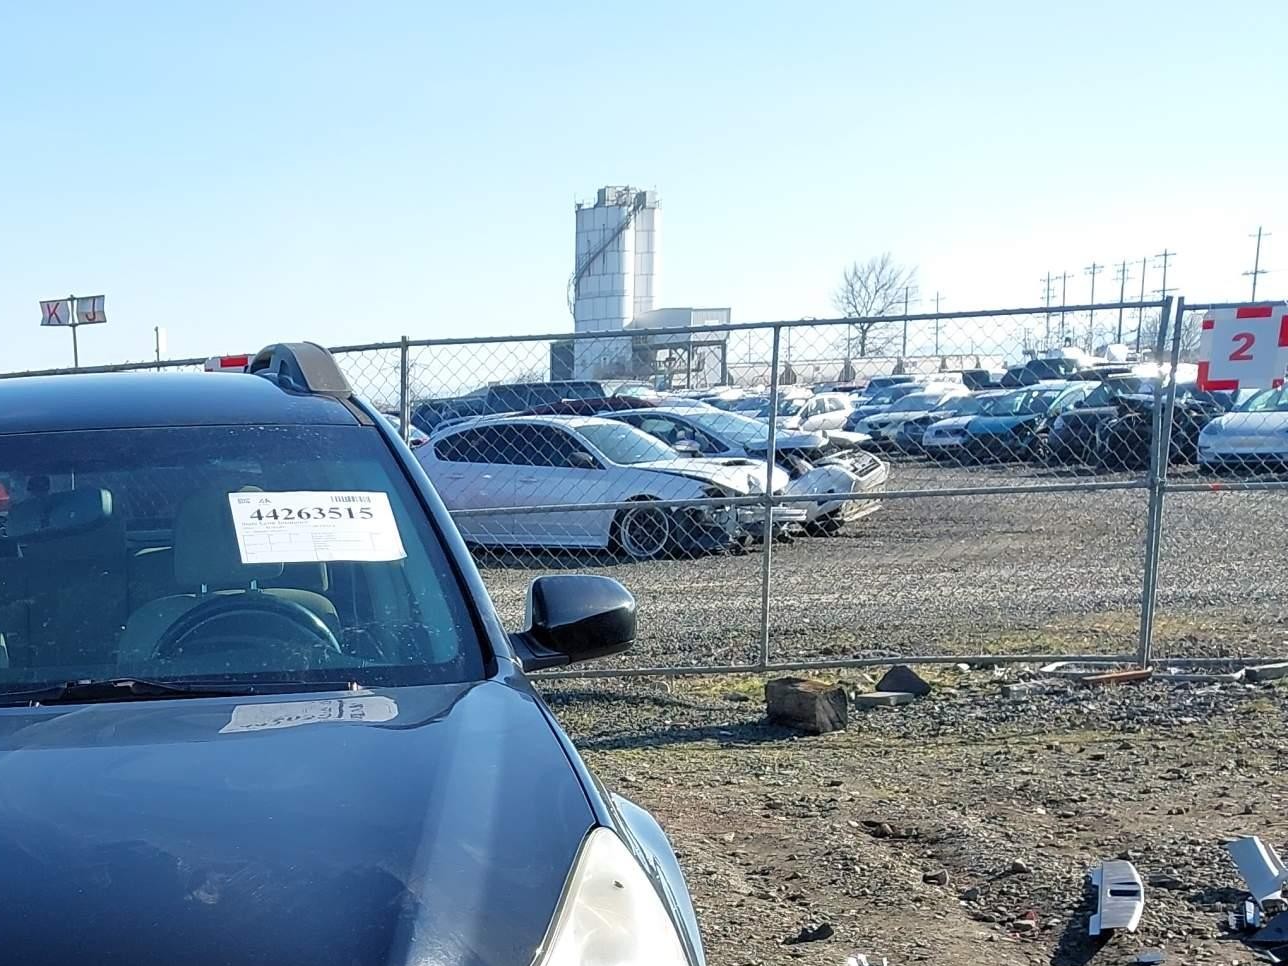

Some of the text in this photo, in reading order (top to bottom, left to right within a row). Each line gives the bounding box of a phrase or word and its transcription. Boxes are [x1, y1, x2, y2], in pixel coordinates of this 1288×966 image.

[47, 302, 62, 324] K
[84, 297, 97, 322] J
[1229, 332, 1256, 361] 2
[249, 507, 374, 521] 44263515
